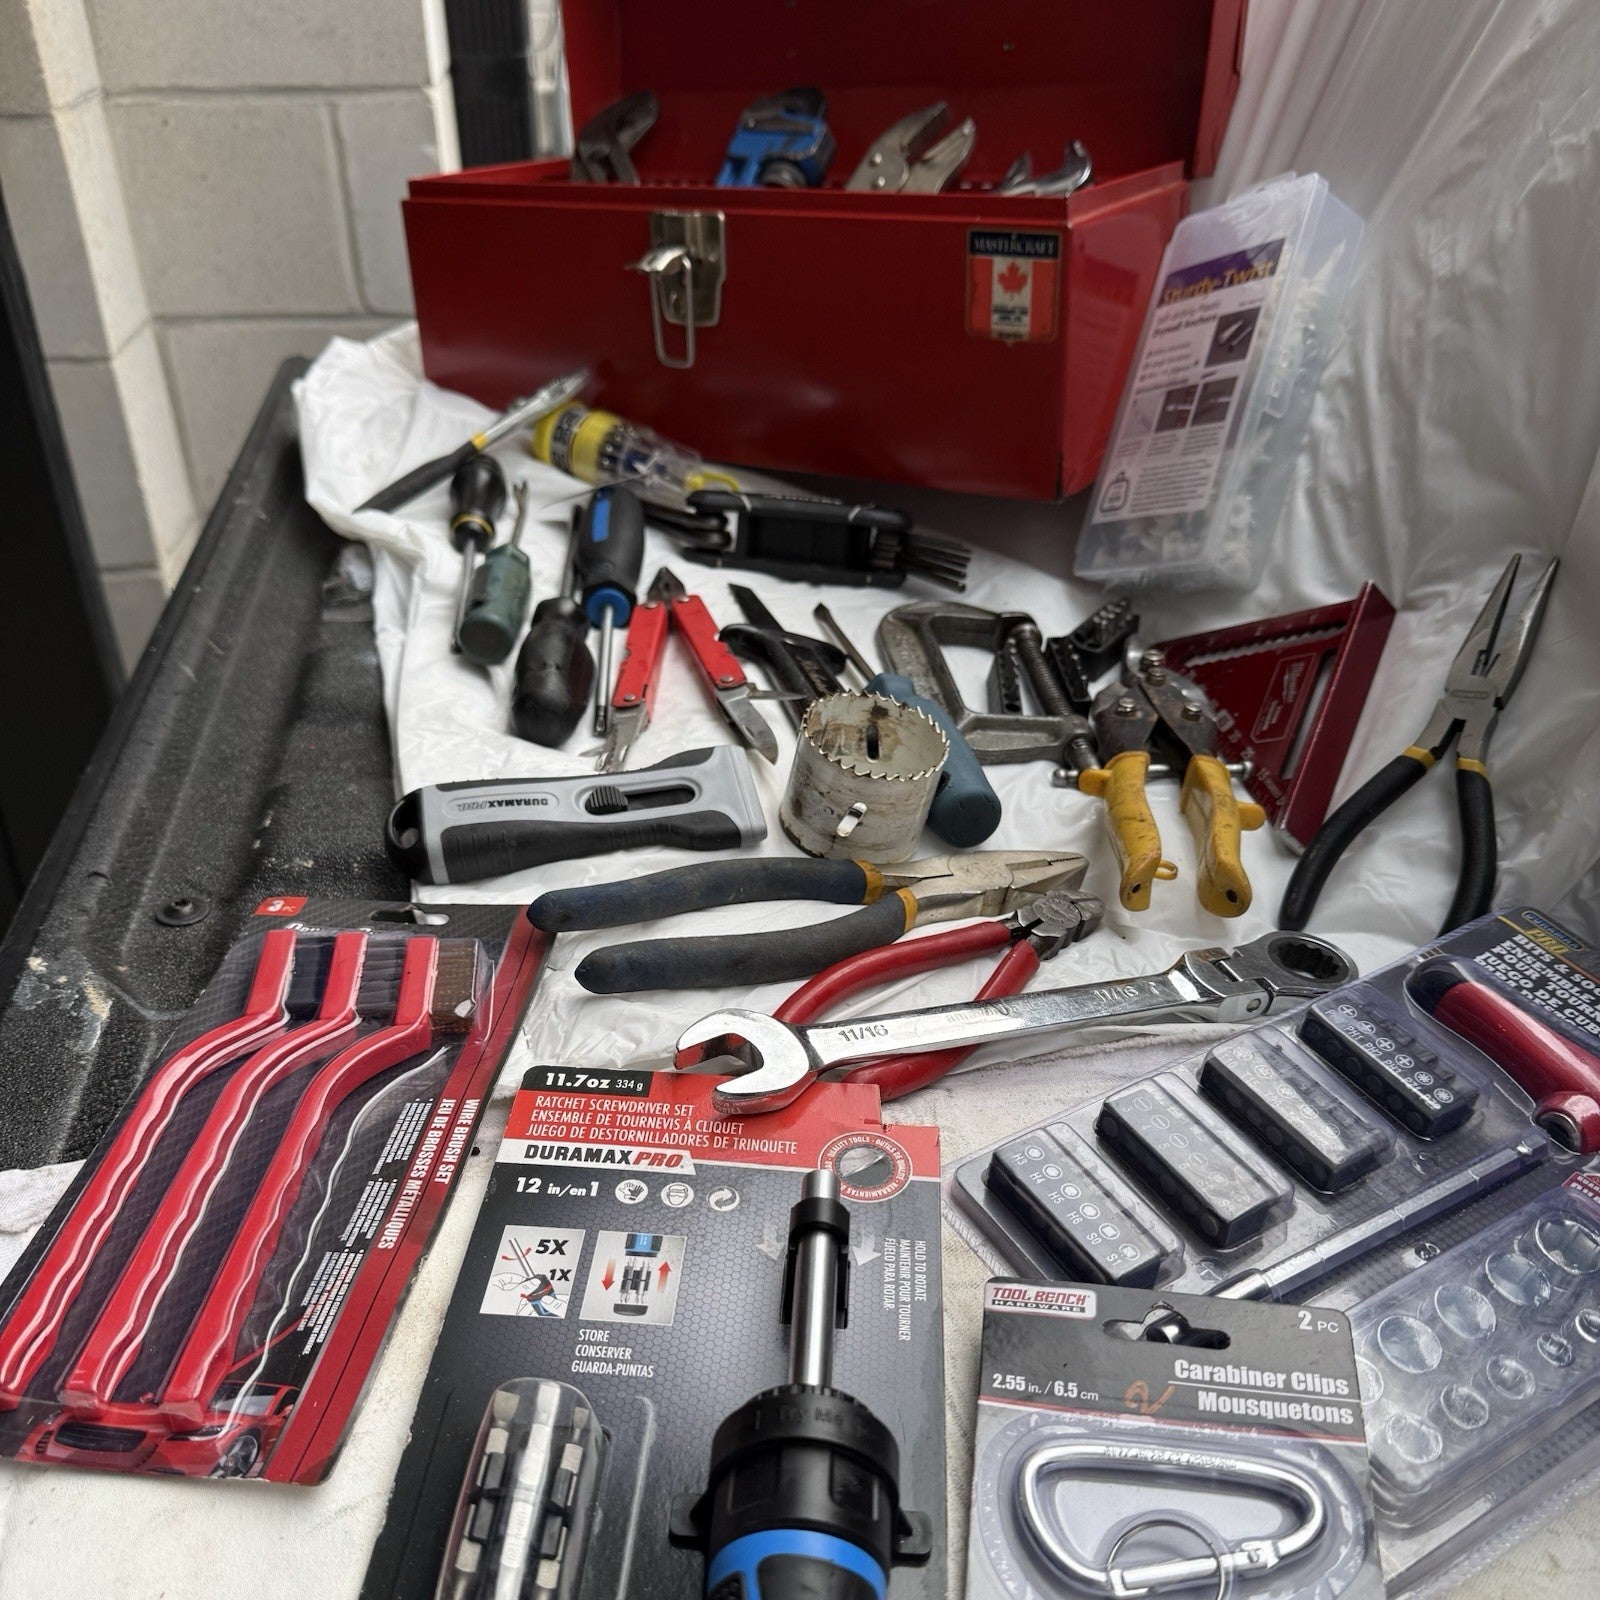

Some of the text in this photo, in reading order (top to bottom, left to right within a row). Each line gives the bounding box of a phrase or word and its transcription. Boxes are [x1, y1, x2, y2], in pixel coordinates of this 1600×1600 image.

[267, 899, 296, 913] 3 PC
[1490, 945, 1541, 980] POUR
[1511, 933, 1555, 963] BITS
[1553, 963, 1570, 975] &
[1500, 940, 1596, 1003] ENSEMBLE
[1093, 985, 1139, 1003] 11/16
[1477, 951, 1534, 988] JUEGO
[1533, 989, 1563, 1008] DE
[1563, 1008, 1600, 1036] CUB
[838, 1024, 889, 1041] 11/16
[1343, 1026, 1362, 1042] PH1
[1362, 1042, 1383, 1058] PH2
[545, 1072, 643, 1091] 11.7oz 334 g
[437, 1098, 457, 1115] JEU
[535, 1096, 695, 1117] RATCHET SCREWDRIVER SET
[430, 1116, 449, 1130] DE
[531, 1110, 745, 1135] ENSEMBLE DE TOURNEVIS À CLIQUET
[434, 1098, 481, 1185] WIRE BRUSH SET
[525, 1124, 798, 1155] JUEGO DE DESTORNILLADORES DE TRINQUETE
[849, 1136, 871, 1144] TOOLS
[410, 1130, 444, 1178] BROSSES
[516, 1176, 600, 1197] 12 in/en 1
[1012, 1152, 1028, 1167] H3
[1029, 1171, 1046, 1185] H4
[1048, 1190, 1065, 1205] H5
[1066, 1210, 1083, 1226] H6
[377, 1179, 424, 1250] MÉTALLIQUES
[535, 1239, 569, 1256] 5X
[550, 1268, 572, 1282] 1X
[884, 1262, 896, 1282] PARA
[914, 1240, 927, 1302] HOLD TO ROTATE
[898, 1238, 912, 1341] MAINTENIR POUR TOURNER
[992, 1287, 1087, 1306] TOOL BENCH
[993, 1299, 1082, 1312] HARDWARE
[1297, 1309, 1339, 1333] 2 PC
[578, 1329, 610, 1342] STORE
[575, 1344, 632, 1360] CONSERVER
[571, 1360, 655, 1378] GUARDA-PUNTAS
[1174, 1359, 1350, 1396] Carabiner Clips
[992, 1373, 1099, 1400] 2.55 in. / 6.5 cm
[1197, 1390, 1354, 1425] Mousquetons
